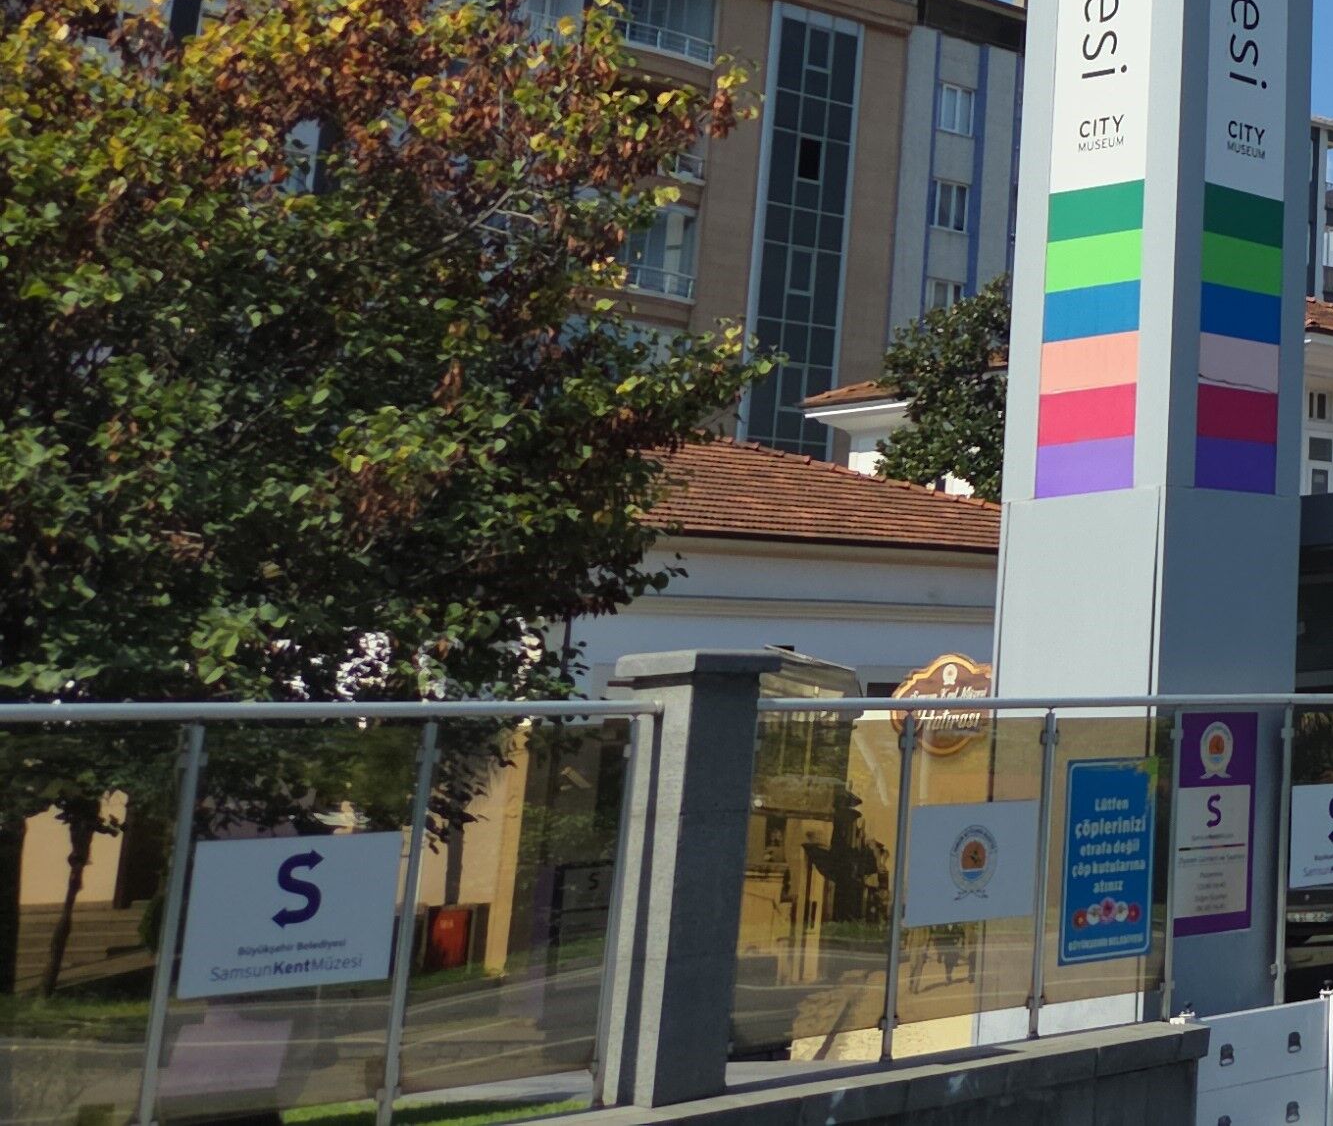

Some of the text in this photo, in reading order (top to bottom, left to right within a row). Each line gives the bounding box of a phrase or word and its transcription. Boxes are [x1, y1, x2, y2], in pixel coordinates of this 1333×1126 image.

[1078, 113, 1125, 139] CITY
[1227, 120, 1266, 145] CITY
[1078, 134, 1125, 152] MUSEUM
[1227, 139, 1266, 159] MUSEUM
[1094, 797, 1130, 812] Lütfen
[1074, 815, 1147, 839] çöplerinizi
[1079, 838, 1141, 857] etrafa değil
[1072, 859, 1146, 879] çöp kutularına
[1093, 879, 1125, 894] atınız
[209, 954, 364, 982] SamsunKentMüzesi
